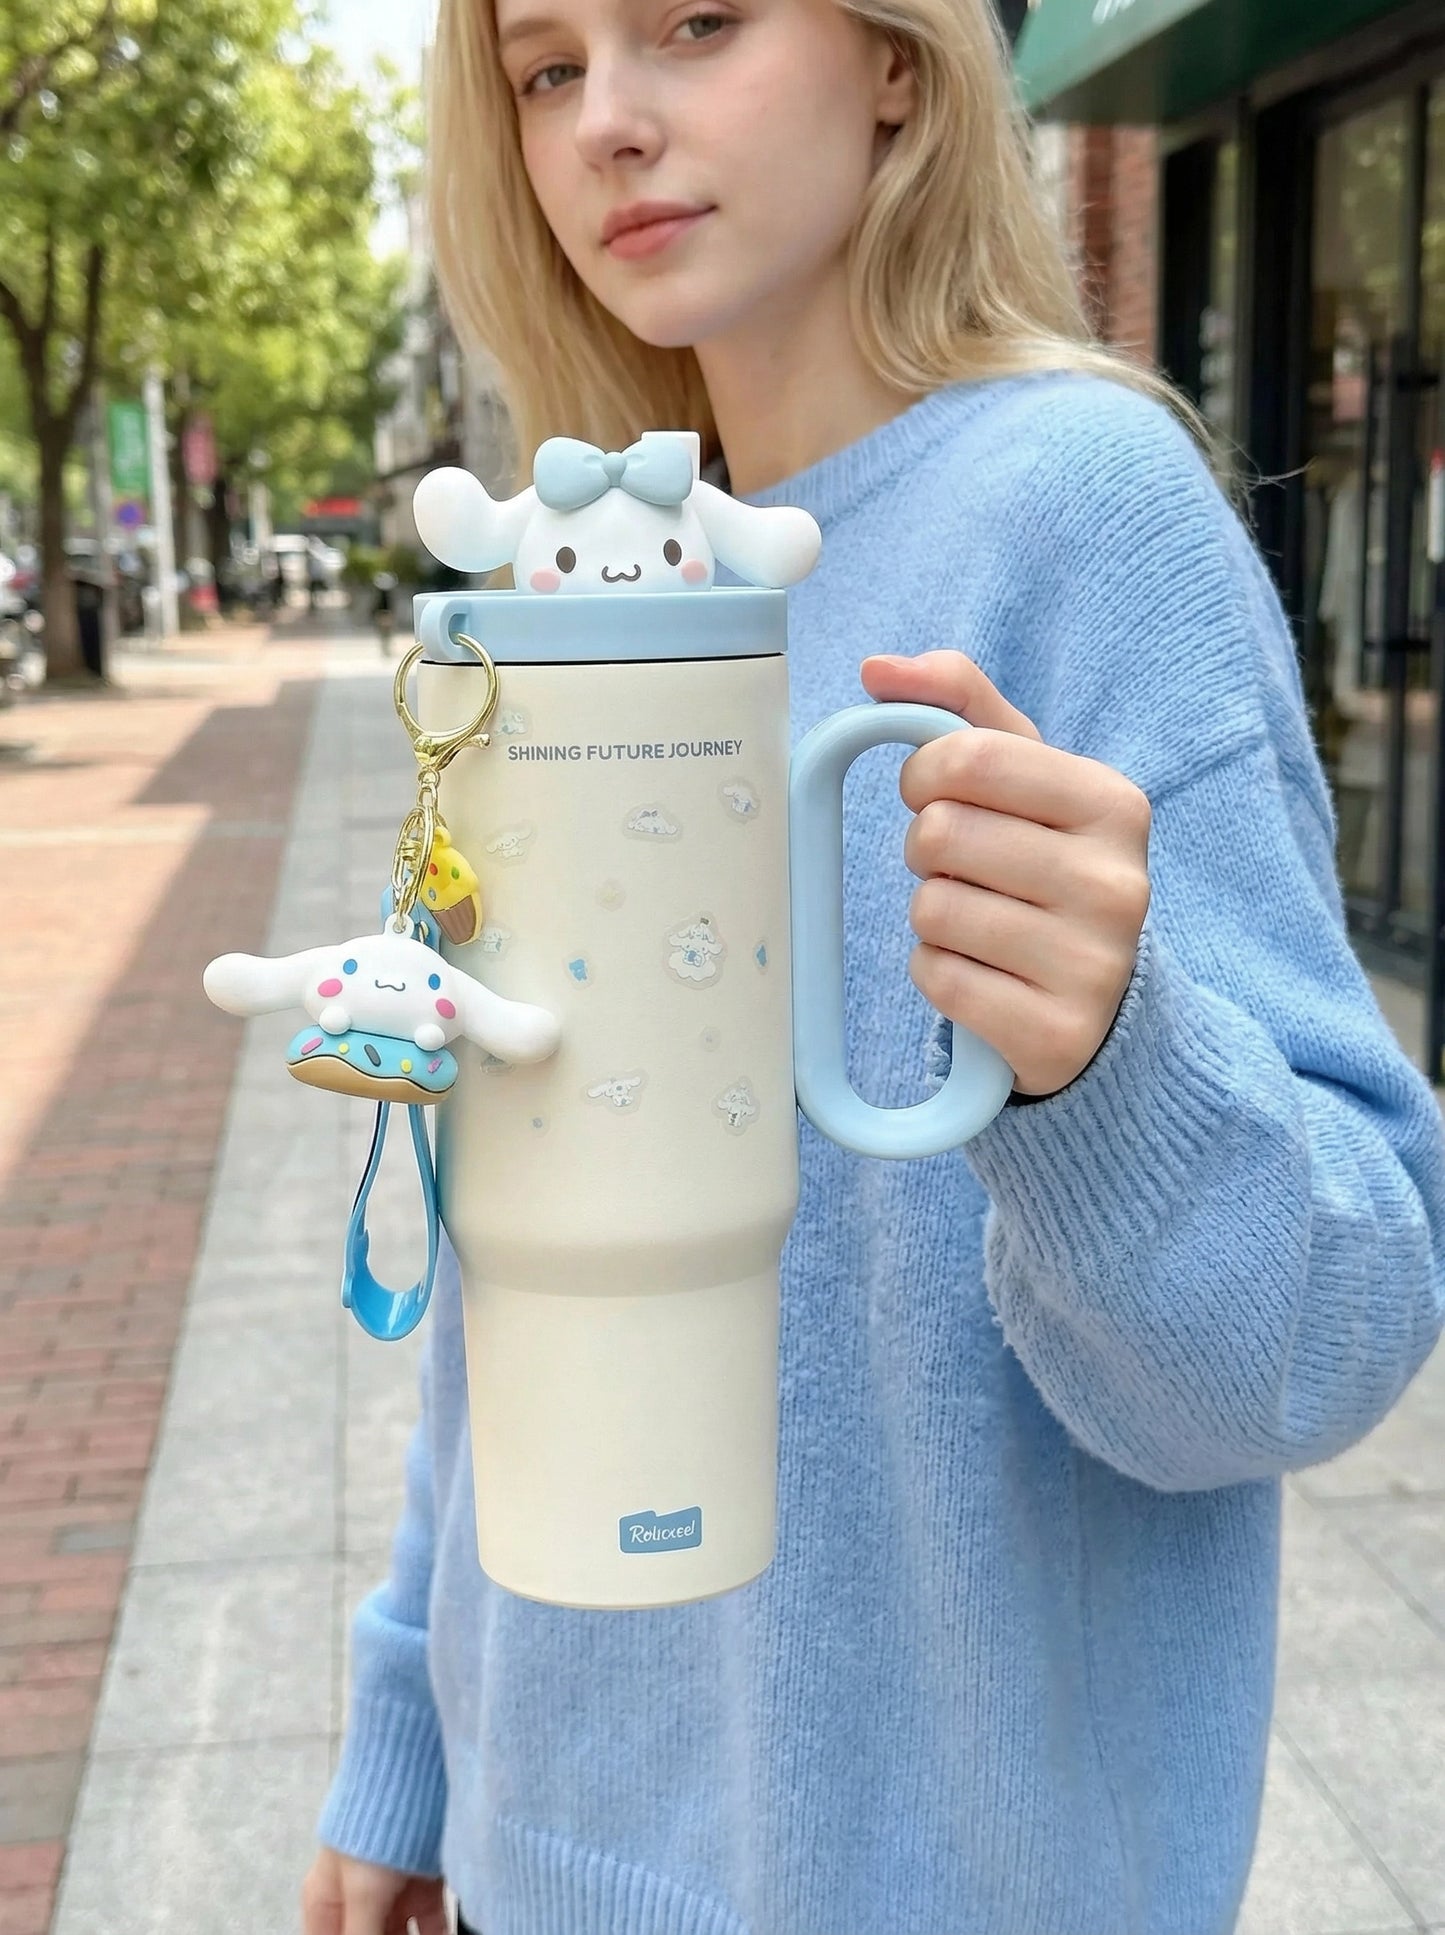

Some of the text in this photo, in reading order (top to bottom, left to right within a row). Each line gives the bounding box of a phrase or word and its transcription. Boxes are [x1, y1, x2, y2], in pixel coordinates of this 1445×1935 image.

[508, 740, 743, 761] SHINING FUTURE JOURNEY
